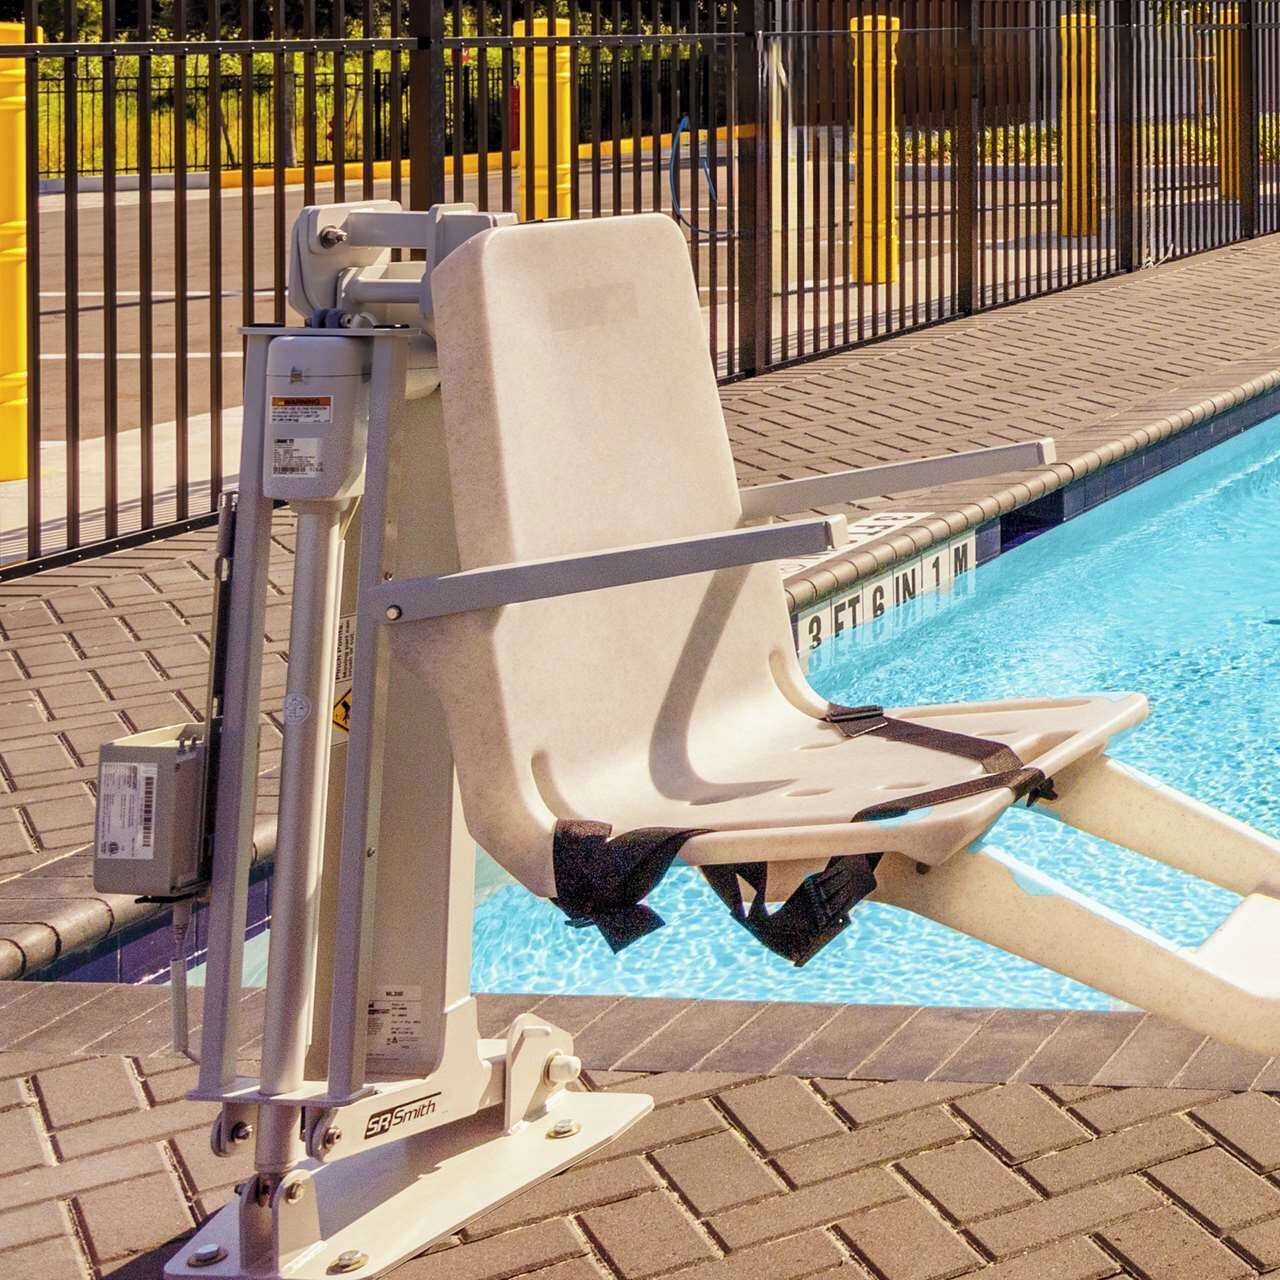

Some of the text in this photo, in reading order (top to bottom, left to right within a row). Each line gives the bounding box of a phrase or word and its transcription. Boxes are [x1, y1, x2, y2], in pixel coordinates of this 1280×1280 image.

[808, 542, 968, 650] 3 FT 6 IN 1 M
[392, 1099, 437, 1127] Smith
